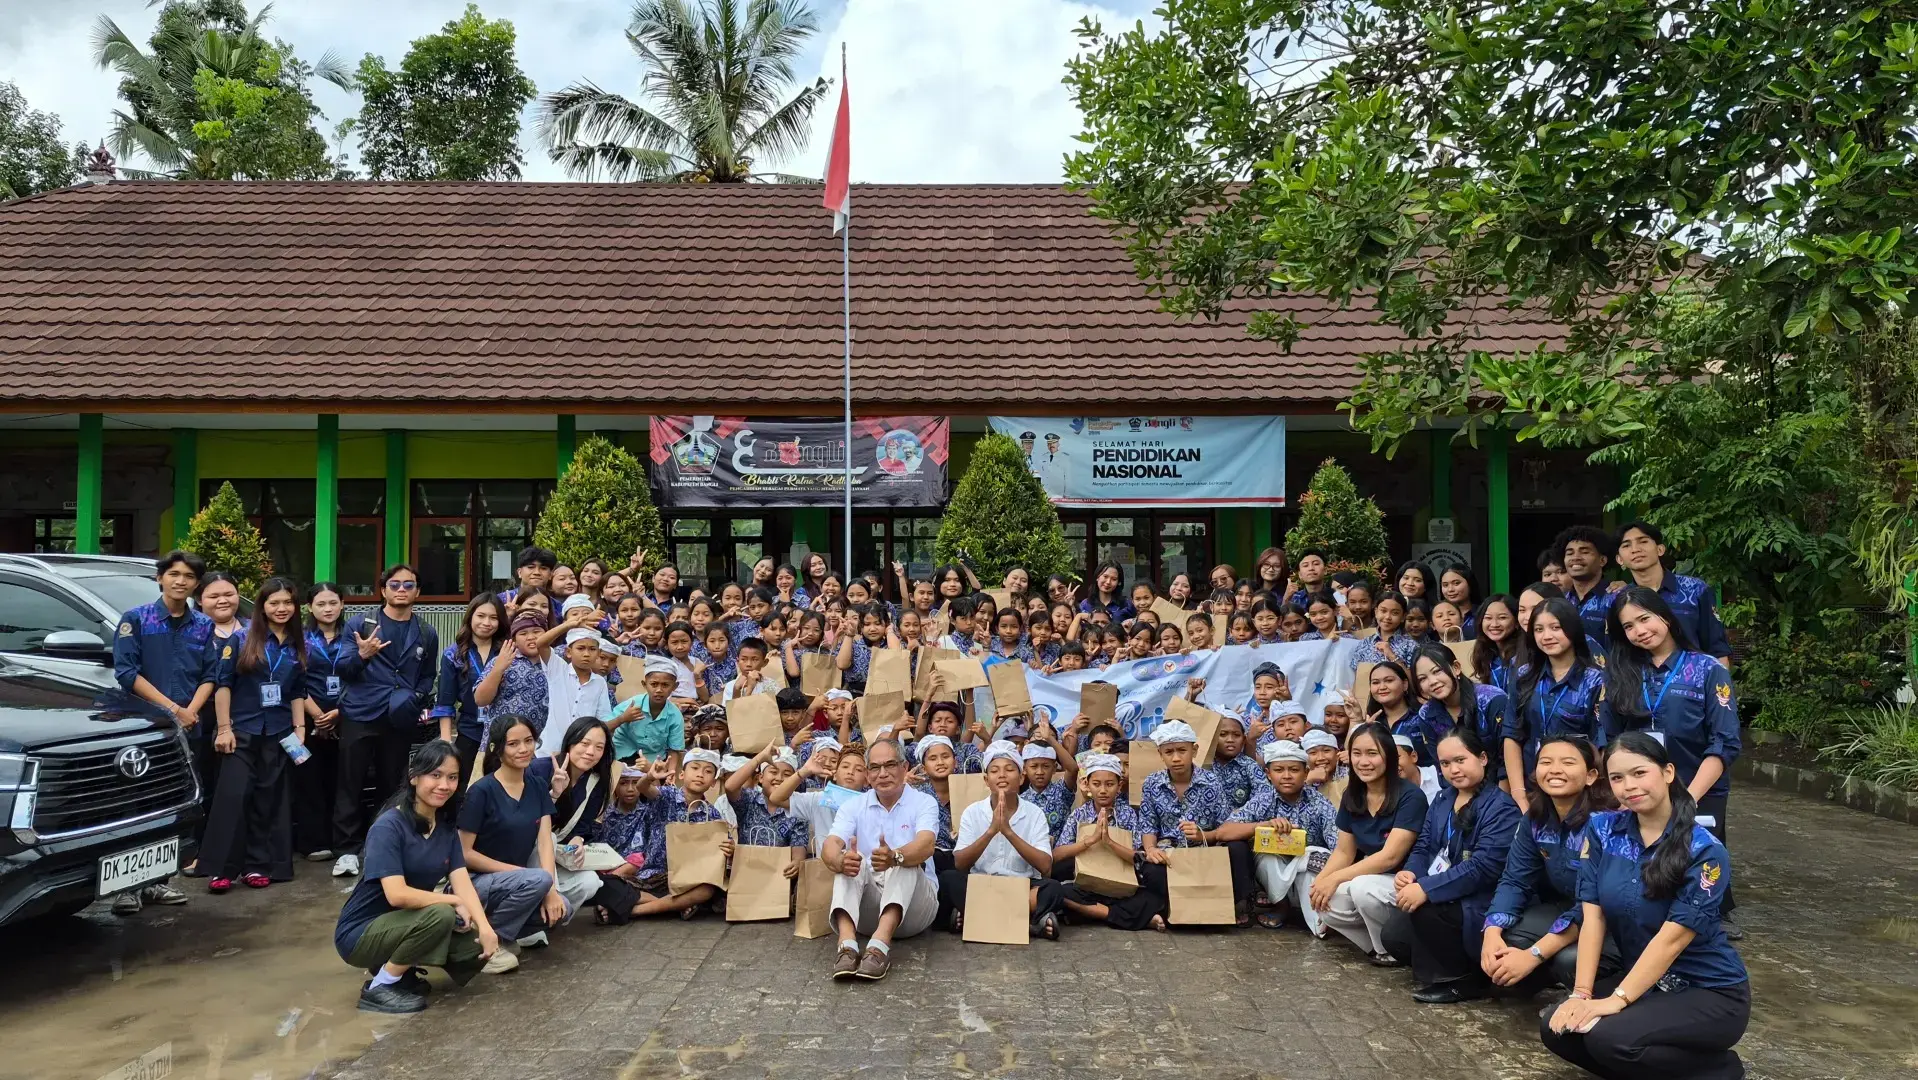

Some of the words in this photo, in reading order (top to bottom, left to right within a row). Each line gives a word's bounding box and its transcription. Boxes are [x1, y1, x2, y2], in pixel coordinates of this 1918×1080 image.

[1145, 417, 1176, 429] Bngli
[764, 440, 845, 468] Bngli
[1093, 448, 1201, 462] PENDIDIKAN
[1093, 464, 1183, 478] NASIONAL
[1115, 700, 1165, 741] Bri
[103, 858, 121, 881] DK
[122, 848, 153, 875] 1240
[155, 841, 177, 866] ADN
